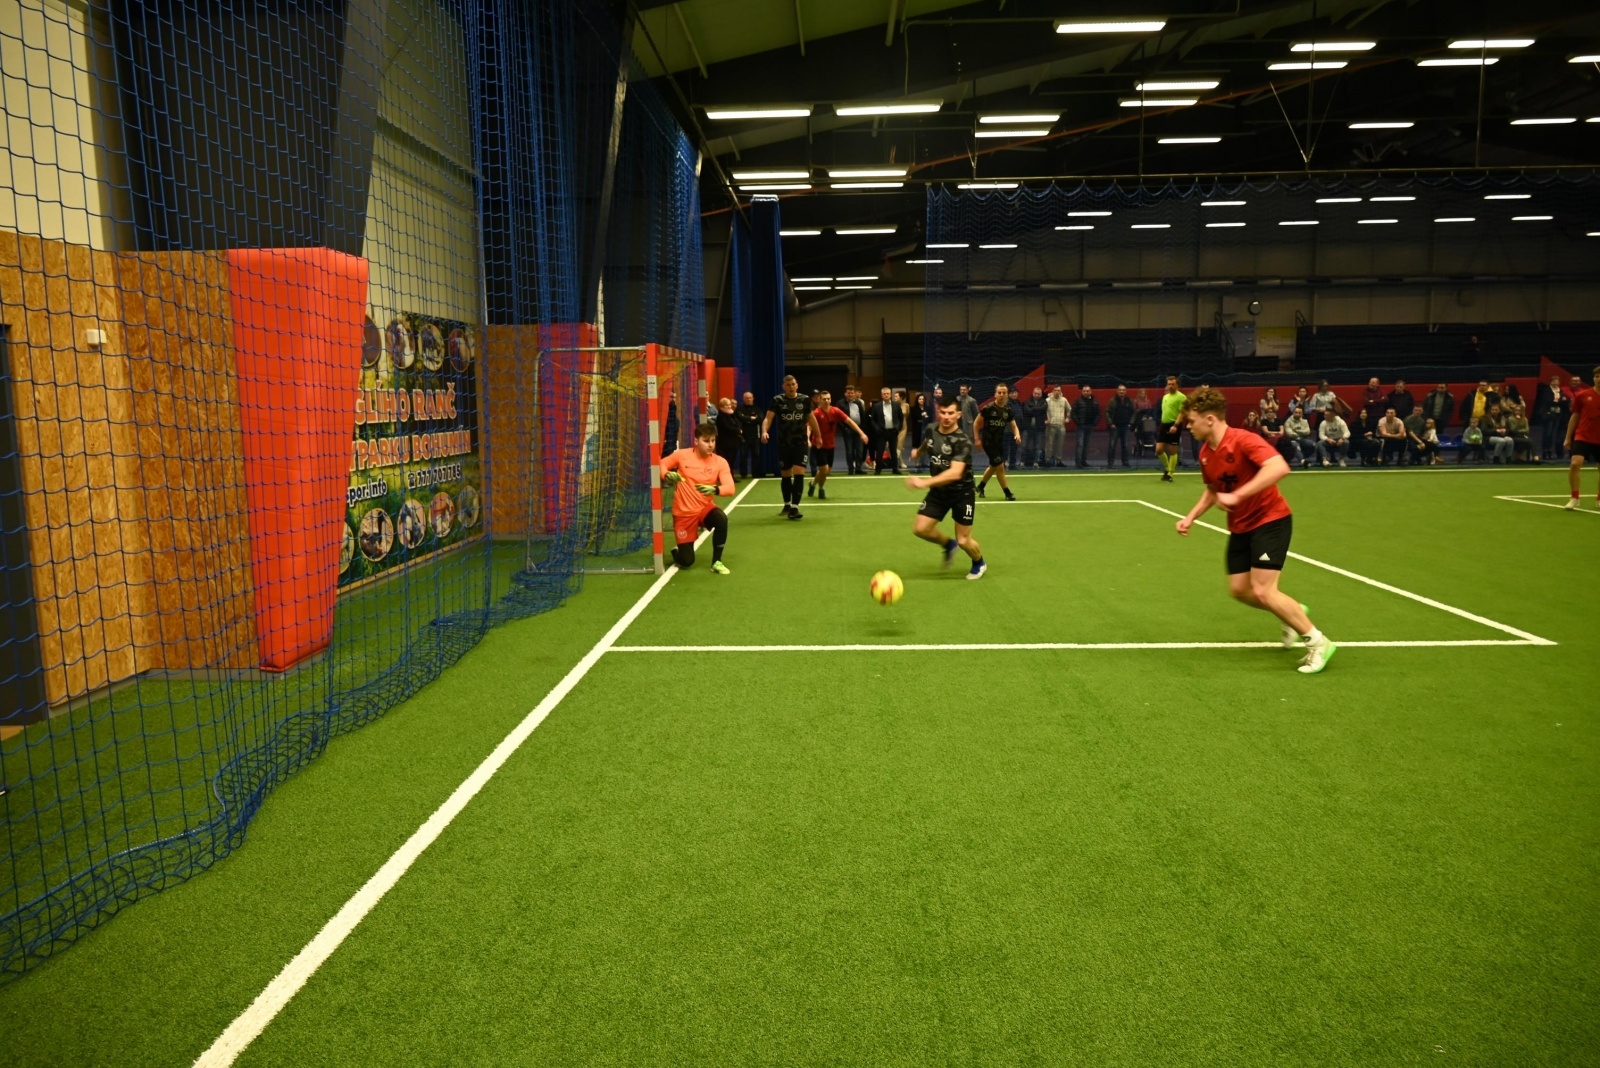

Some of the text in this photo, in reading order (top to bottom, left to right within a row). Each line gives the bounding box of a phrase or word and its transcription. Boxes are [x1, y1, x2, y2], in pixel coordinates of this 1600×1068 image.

[412, 382, 457, 421] RANČ
[781, 411, 804, 421] safer
[412, 425, 471, 461] BOHUMÍN
[347, 476, 387, 507] por.info
[416, 468, 431, 488] 777
[432, 465, 447, 484] 707
